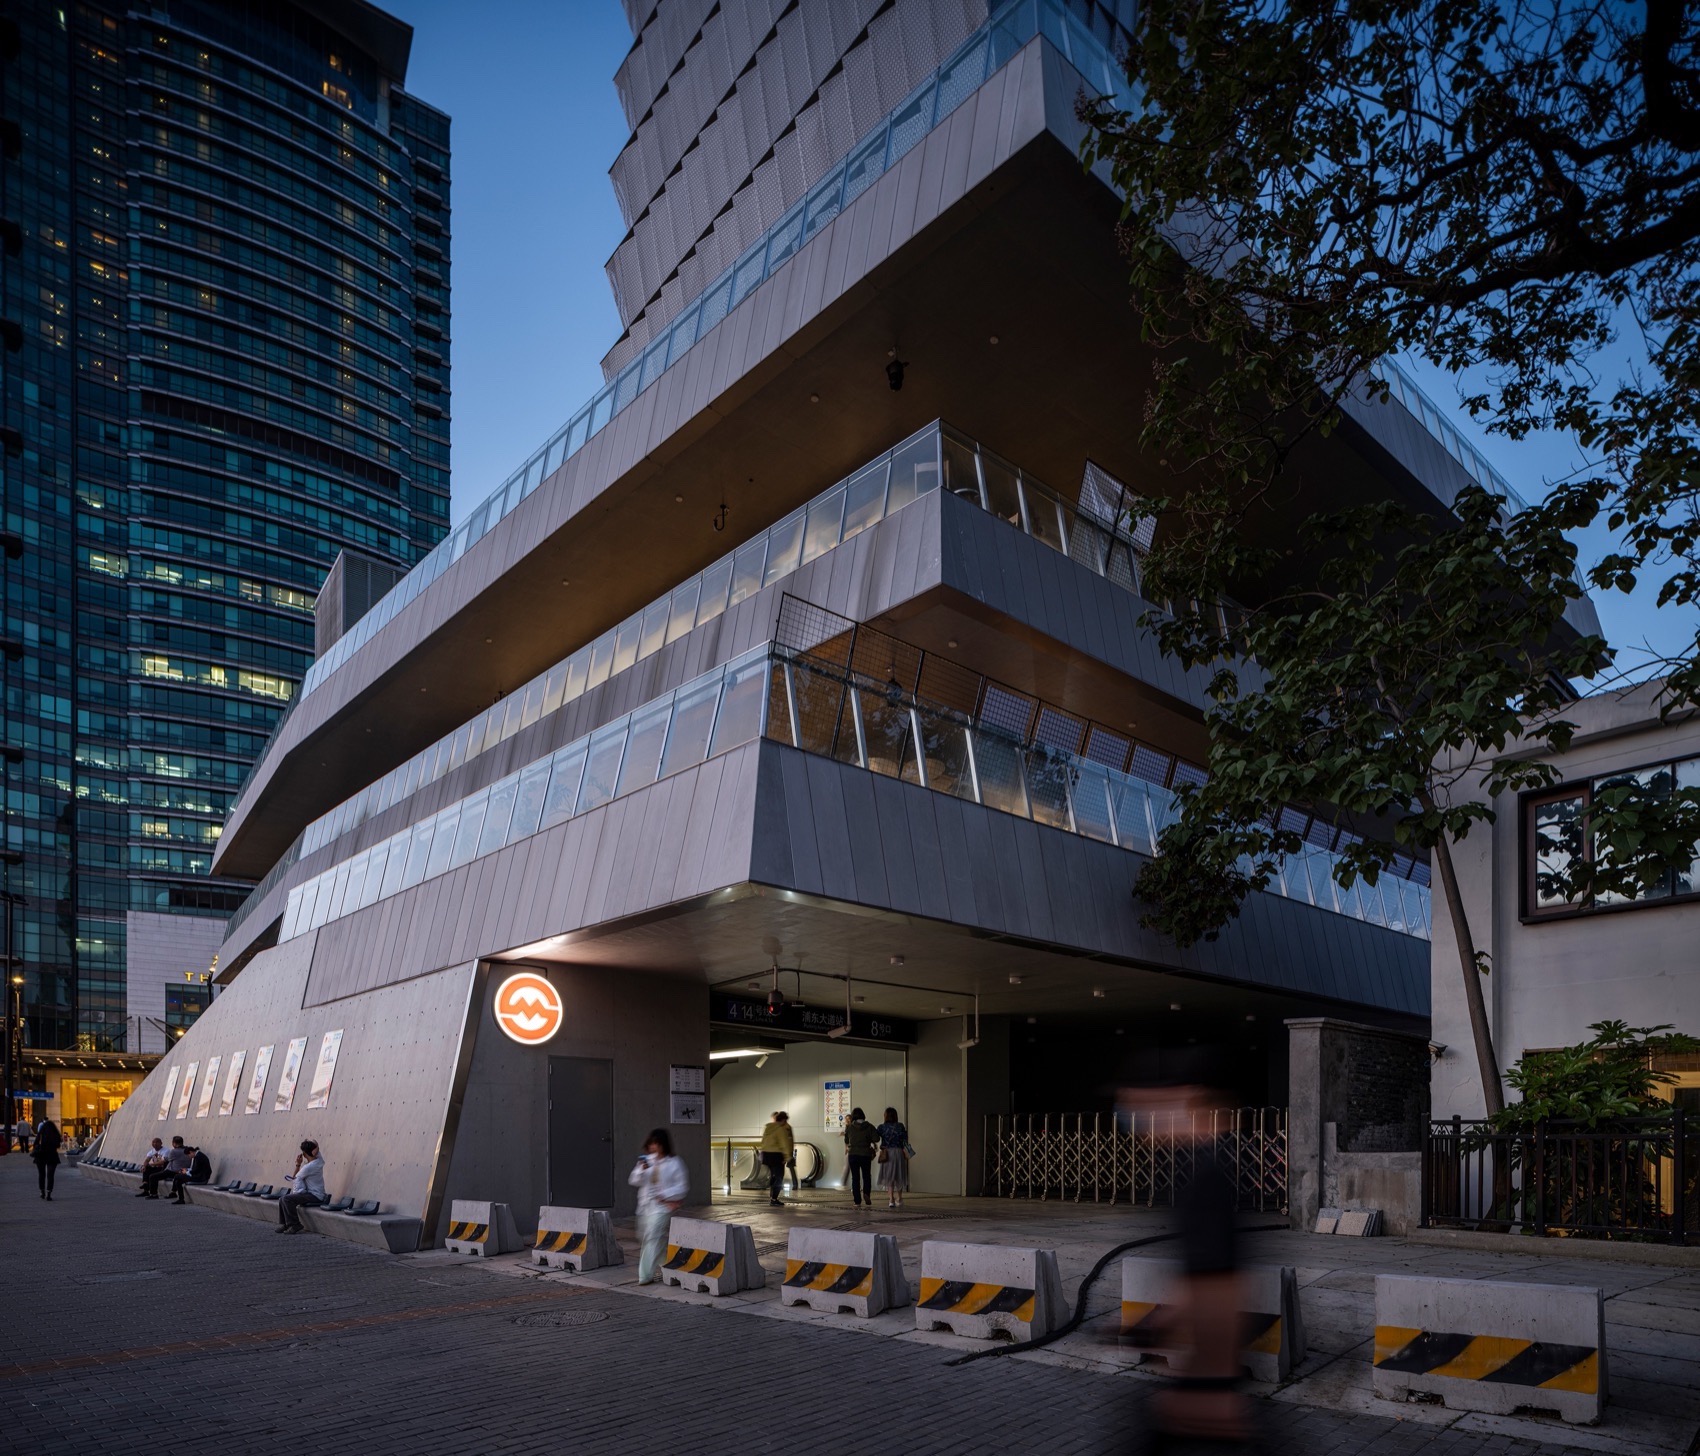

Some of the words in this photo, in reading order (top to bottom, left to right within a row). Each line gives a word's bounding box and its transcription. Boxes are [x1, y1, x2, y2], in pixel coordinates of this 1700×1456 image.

[729, 1003, 738, 1018] 4
[741, 1004, 754, 1020] 14
[802, 1010, 844, 1026] 浦东大道站
